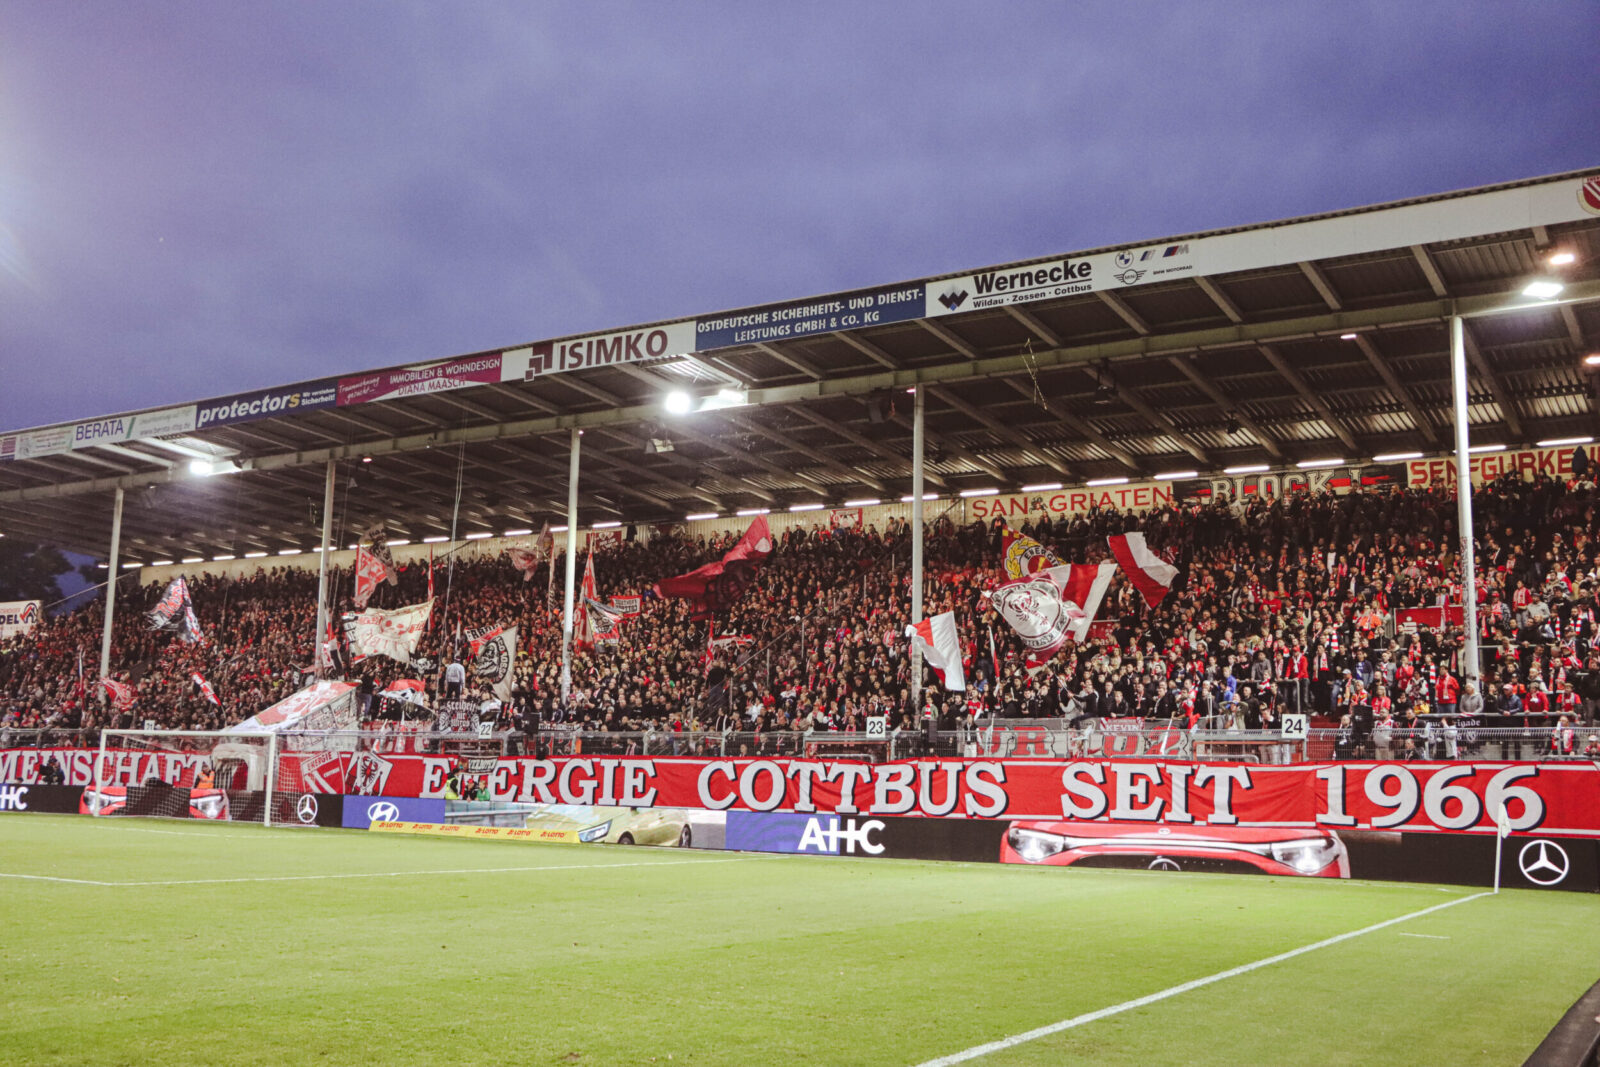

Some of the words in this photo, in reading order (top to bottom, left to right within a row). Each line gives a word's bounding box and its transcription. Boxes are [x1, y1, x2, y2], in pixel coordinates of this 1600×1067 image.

[974, 260, 1092, 294] Wernecke
[697, 312, 769, 333] OSTDEUTSCHE
[772, 302, 845, 326] SICHERHEITS-
[849, 294, 874, 310] UND
[878, 288, 924, 305] DIENST-
[973, 298, 1004, 309] Wildau
[1012, 291, 1046, 303] Zossen
[1054, 283, 1092, 296] Cottbus
[734, 324, 791, 342] LEISTUNGS
[794, 319, 827, 333] GMBH
[829, 317, 838, 328] &
[841, 314, 860, 326] CO.
[864, 311, 880, 322] KG
[559, 329, 669, 371] ISIMKO
[389, 369, 435, 384] IMMOBILIEN
[436, 367, 443, 376] &
[445, 358, 500, 374] WOHNDESIGN
[301, 394, 336, 406] Sicherheit!
[398, 381, 426, 396] DIANA
[197, 393, 301, 427] protectors
[75, 419, 124, 441] BERATA
[972, 497, 1028, 518] SAN
[1049, 485, 1171, 512] GRIATEN
[1211, 470, 1335, 506] BLOCK
[480, 724, 491, 735] 22
[868, 720, 884, 735] 23
[1284, 718, 1303, 734] 24
[697, 759, 1009, 819] COTTBUS
[1060, 761, 1253, 825] SEIT
[1316, 764, 1548, 832] 1966
[798, 818, 886, 854] AHC
